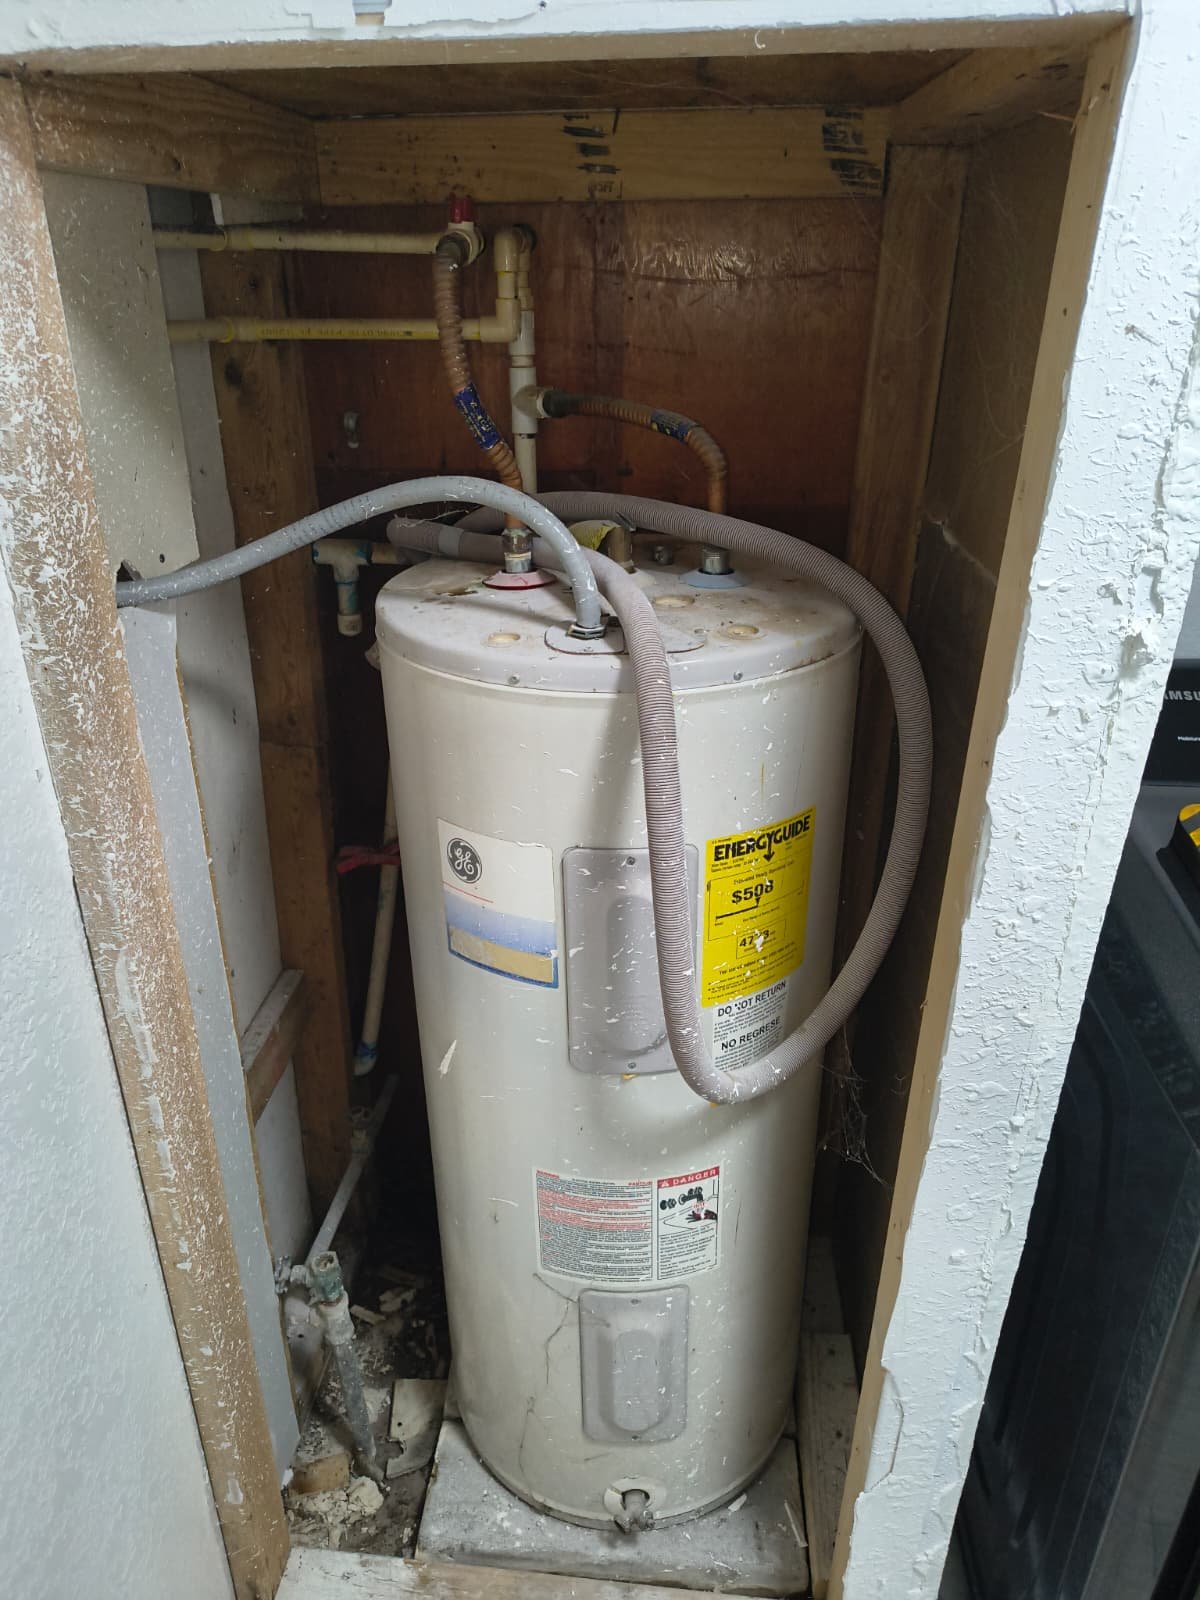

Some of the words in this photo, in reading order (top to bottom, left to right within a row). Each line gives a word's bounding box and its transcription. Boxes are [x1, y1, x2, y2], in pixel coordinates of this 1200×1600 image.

[714, 815, 811, 862] ENERGYGUIDE
[731, 880, 774, 904] $508
[718, 1005, 732, 1017] DO
[755, 980, 786, 1001] RETURN
[721, 1038, 736, 1051] NO
[740, 1016, 781, 1044] REGRESE
[672, 1169, 716, 1186] DANGER
